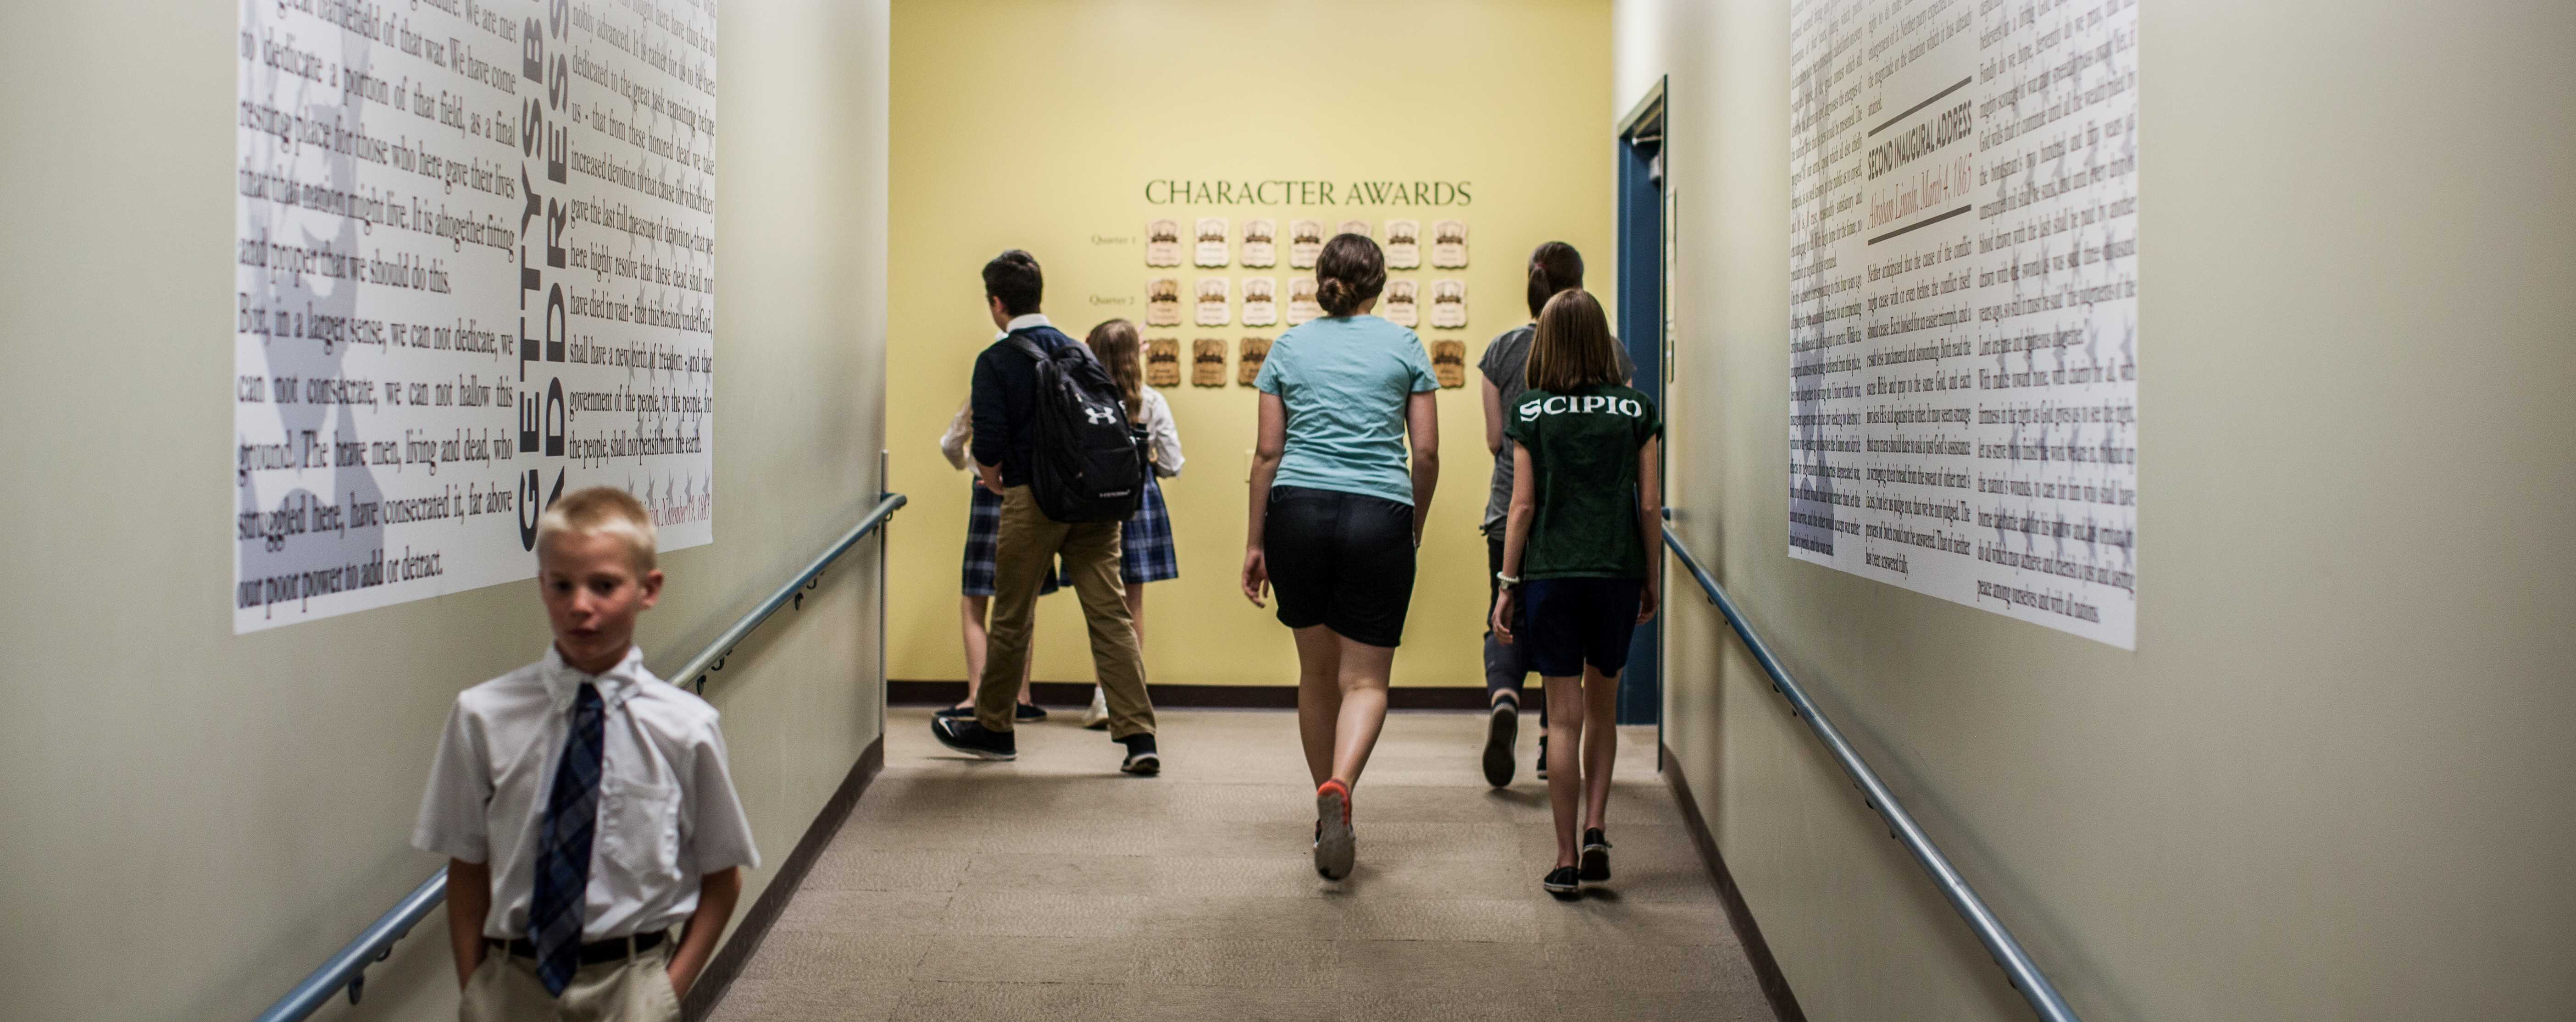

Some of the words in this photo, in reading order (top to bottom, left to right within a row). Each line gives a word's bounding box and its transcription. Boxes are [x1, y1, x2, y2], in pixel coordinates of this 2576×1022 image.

[572, 101, 581, 123] us
[592, 101, 606, 133] that
[609, 107, 626, 141] from
[628, 117, 645, 149] these
[648, 125, 673, 160] honored
[676, 137, 690, 167] dead
[693, 152, 700, 171] we
[703, 151, 714, 177] take
[1868, 139, 1893, 181] SECOND
[1894, 118, 1934, 169] INAUGURAL
[1936, 99, 1971, 149] ADDRESS
[571, 140, 606, 180] increased
[607, 153, 636, 190] devotion
[637, 169, 644, 193] to
[644, 168, 657, 197] that
[658, 180, 675, 203] cause
[675, 178, 684, 206] for
[684, 184, 701, 212] which
[702, 189, 714, 226] they
[1145, 180, 1336, 206] CHARACTER
[1345, 181, 1472, 207] AWARDS
[1867, 188, 1894, 229] Abraham
[1895, 176, 1918, 219] Lincoln,
[1920, 164, 1942, 210] March
[1943, 162, 1950, 207] 4,
[1953, 151, 1971, 198] 1865
[570, 197, 588, 230] gave
[590, 195, 601, 225] the
[602, 198, 615, 229] last
[616, 202, 627, 232] full
[628, 215, 655, 240] measure
[656, 215, 663, 242] of
[664, 217, 689, 249] devotion
[694, 227, 705, 254] that
[705, 238, 713, 256] we
[1091, 235, 1128, 246] Quarter
[519, 0, 543, 552] GETTYSB
[570, 236, 587, 268] here
[590, 241, 612, 285] highly
[615, 250, 638, 279] resolve
[640, 254, 653, 282] that
[655, 258, 671, 286] these
[673, 261, 687, 289] dead
[689, 266, 702, 293] shall
[704, 275, 713, 295] not
[570, 284, 588, 316] have
[589, 288, 605, 318] died
[606, 292, 613, 320] in
[615, 294, 628, 322] vain
[634, 297, 647, 325] that
[648, 299, 660, 326] this
[661, 303, 681, 336] nation,
[682, 306, 699, 332] under
[699, 309, 712, 340] God,
[1089, 294, 1127, 306] Quarter
[239, 295, 271, 345] But,
[274, 298, 290, 337] in
[294, 314, 303, 337] a
[349, 320, 387, 354] sense,
[390, 324, 407, 347] we
[410, 326, 430, 348] can
[433, 326, 451, 350] not
[454, 318, 498, 362] dedicate,
[500, 336, 513, 355] we
[570, 333, 588, 363] shall
[590, 335, 606, 365] have
[609, 346, 613, 365] a
[615, 347, 630, 367] new
[631, 340, 647, 368] birth
[649, 343, 656, 369] of
[659, 343, 683, 371] freedom
[689, 348, 700, 372] and
[701, 348, 712, 374] that
[237, 377, 265, 402] can
[273, 375, 299, 403] not
[306, 378, 378, 414] consecrate,
[384, 383, 402, 405] we
[409, 385, 428, 406] can
[435, 382, 453, 406] not
[459, 374, 491, 407] hallow
[496, 376, 513, 408] this
[569, 389, 612, 423] government
[614, 384, 622, 412] of
[625, 385, 635, 412] the
[637, 386, 660, 423] people,
[662, 387, 669, 423] by
[671, 387, 681, 413] the
[682, 388, 702, 423] people,
[704, 389, 712, 414] for
[1866, 383, 1876, 395] same
[1877, 377, 1887, 394] Bible
[1897, 380, 1906, 400] pray
[1908, 377, 1912, 392] to
[1922, 377, 1934, 391] same
[1935, 371, 1947, 395] God,
[1949, 370, 1958, 390] and
[1960, 369, 1971, 389] each
[1519, 396, 1643, 422] SCIPIO
[300, 430, 329, 468] The
[372, 442, 402, 473] men,
[405, 429, 437, 475] living
[441, 429, 460, 462] and
[464, 429, 491, 468] dead,
[494, 428, 513, 459] who
[569, 429, 582, 459] the
[583, 429, 609, 470] people,
[610, 429, 626, 457] shall
[627, 434, 638, 456] not
[639, 429, 659, 466] perish
[660, 429, 674, 454] from
[675, 428, 684, 454] the
[685, 428, 701, 453] earth.
[311, 493, 344, 538] here,
[350, 491, 378, 527] have
[383, 485, 449, 524] consecrated
[454, 485, 464, 524] it,
[468, 483, 482, 515] far
[487, 481, 513, 513] above
[661, 496, 688, 526] November
[698, 493, 710, 521] 1863
[1866, 490, 1876, 513] faces,
[1888, 498, 1893, 511] us
[1893, 494, 1904, 519] judge
[1904, 498, 1913, 519] not,
[1913, 496, 1921, 515] that
[1921, 503, 1928, 516] we
[1928, 497, 1934, 516] be
[1943, 499, 1960, 528] judged.
[1961, 502, 1971, 522] The
[1871, 548, 1881, 567] been
[1881, 553, 1899, 571] answered
[1899, 554, 1908, 581] fully.
